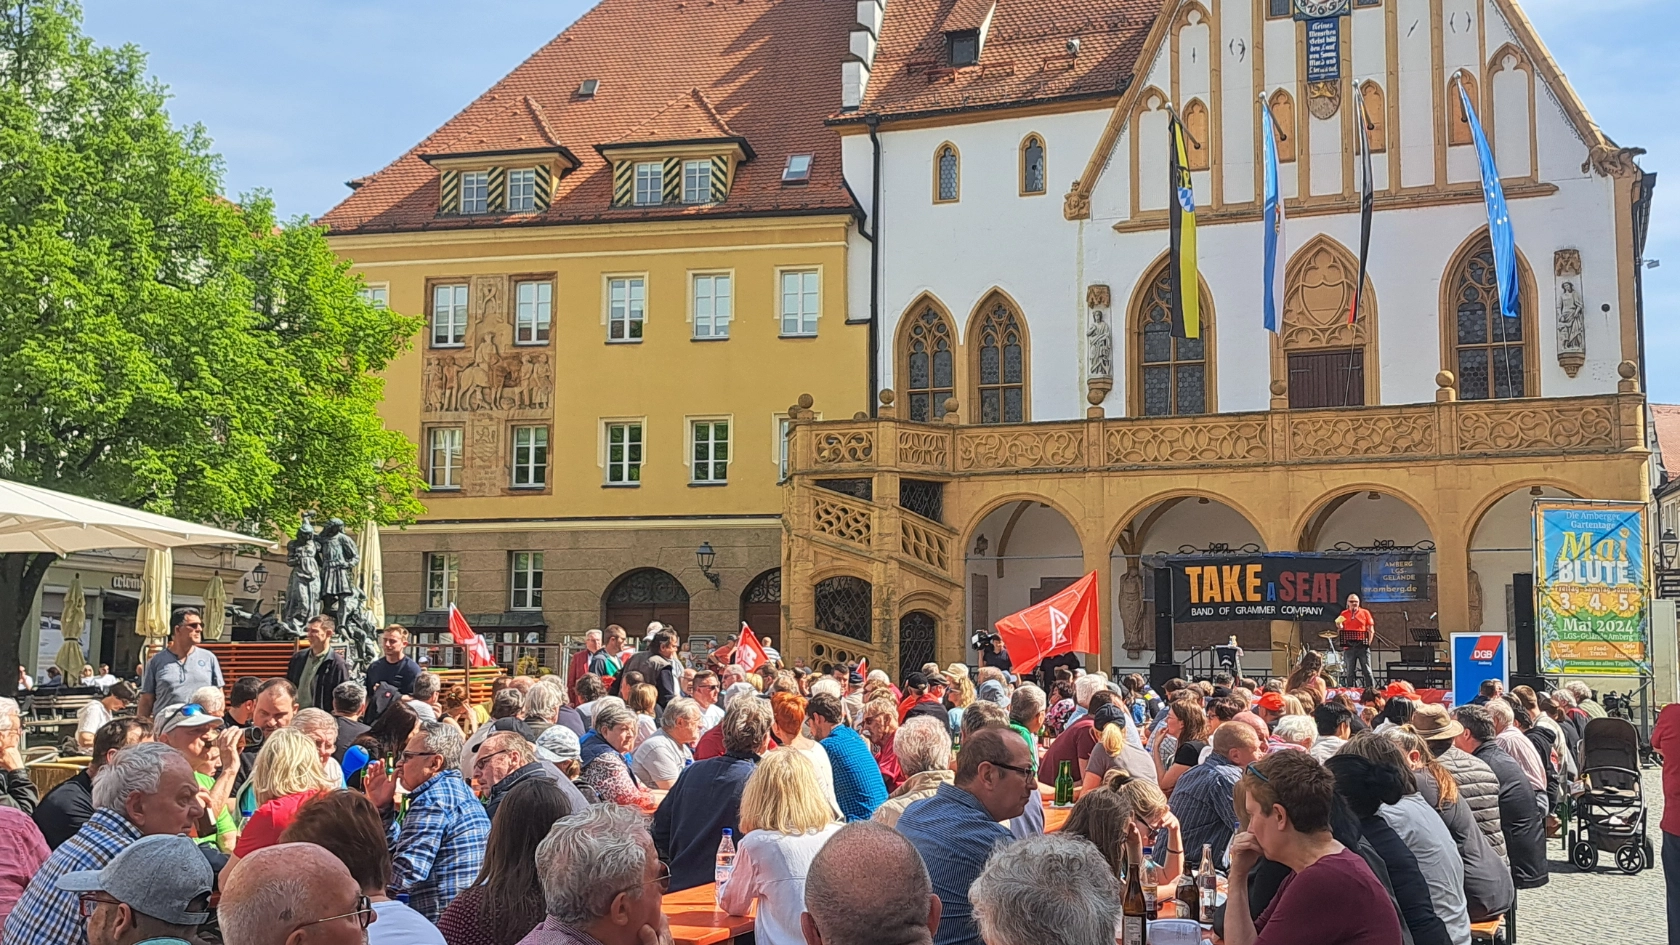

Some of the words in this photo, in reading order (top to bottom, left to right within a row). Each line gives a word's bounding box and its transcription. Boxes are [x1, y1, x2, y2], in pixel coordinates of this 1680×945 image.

[1318, 6, 1325, 15] 6
[1328, 2, 1337, 10] 5
[1566, 512, 1579, 520] Die
[1581, 512, 1620, 522] Amberger
[1571, 521, 1616, 530] Gartentage
[1560, 528, 1630, 562] Mai
[1559, 554, 1629, 584] BLÜTE
[1184, 564, 1263, 604] TAKE
[1266, 582, 1276, 602] A
[1279, 571, 1341, 604] SEAT
[1361, 584, 1417, 593] er.amberg.de
[1555, 585, 1579, 594] Freitag
[1584, 586, 1610, 594] Samstag
[1560, 593, 1576, 610] 3.
[1589, 594, 1607, 611] 4.
[1619, 594, 1635, 611] 5.
[1191, 608, 1214, 616] BAND
[1219, 606, 1230, 615] OF
[1235, 605, 1276, 615] GRAMMER
[1280, 606, 1324, 616] COMPANY
[1563, 617, 1592, 632] Mai
[1596, 620, 1634, 634] 2024
[1609, 633, 1633, 641] Amberg
[1474, 650, 1493, 659] DGB
